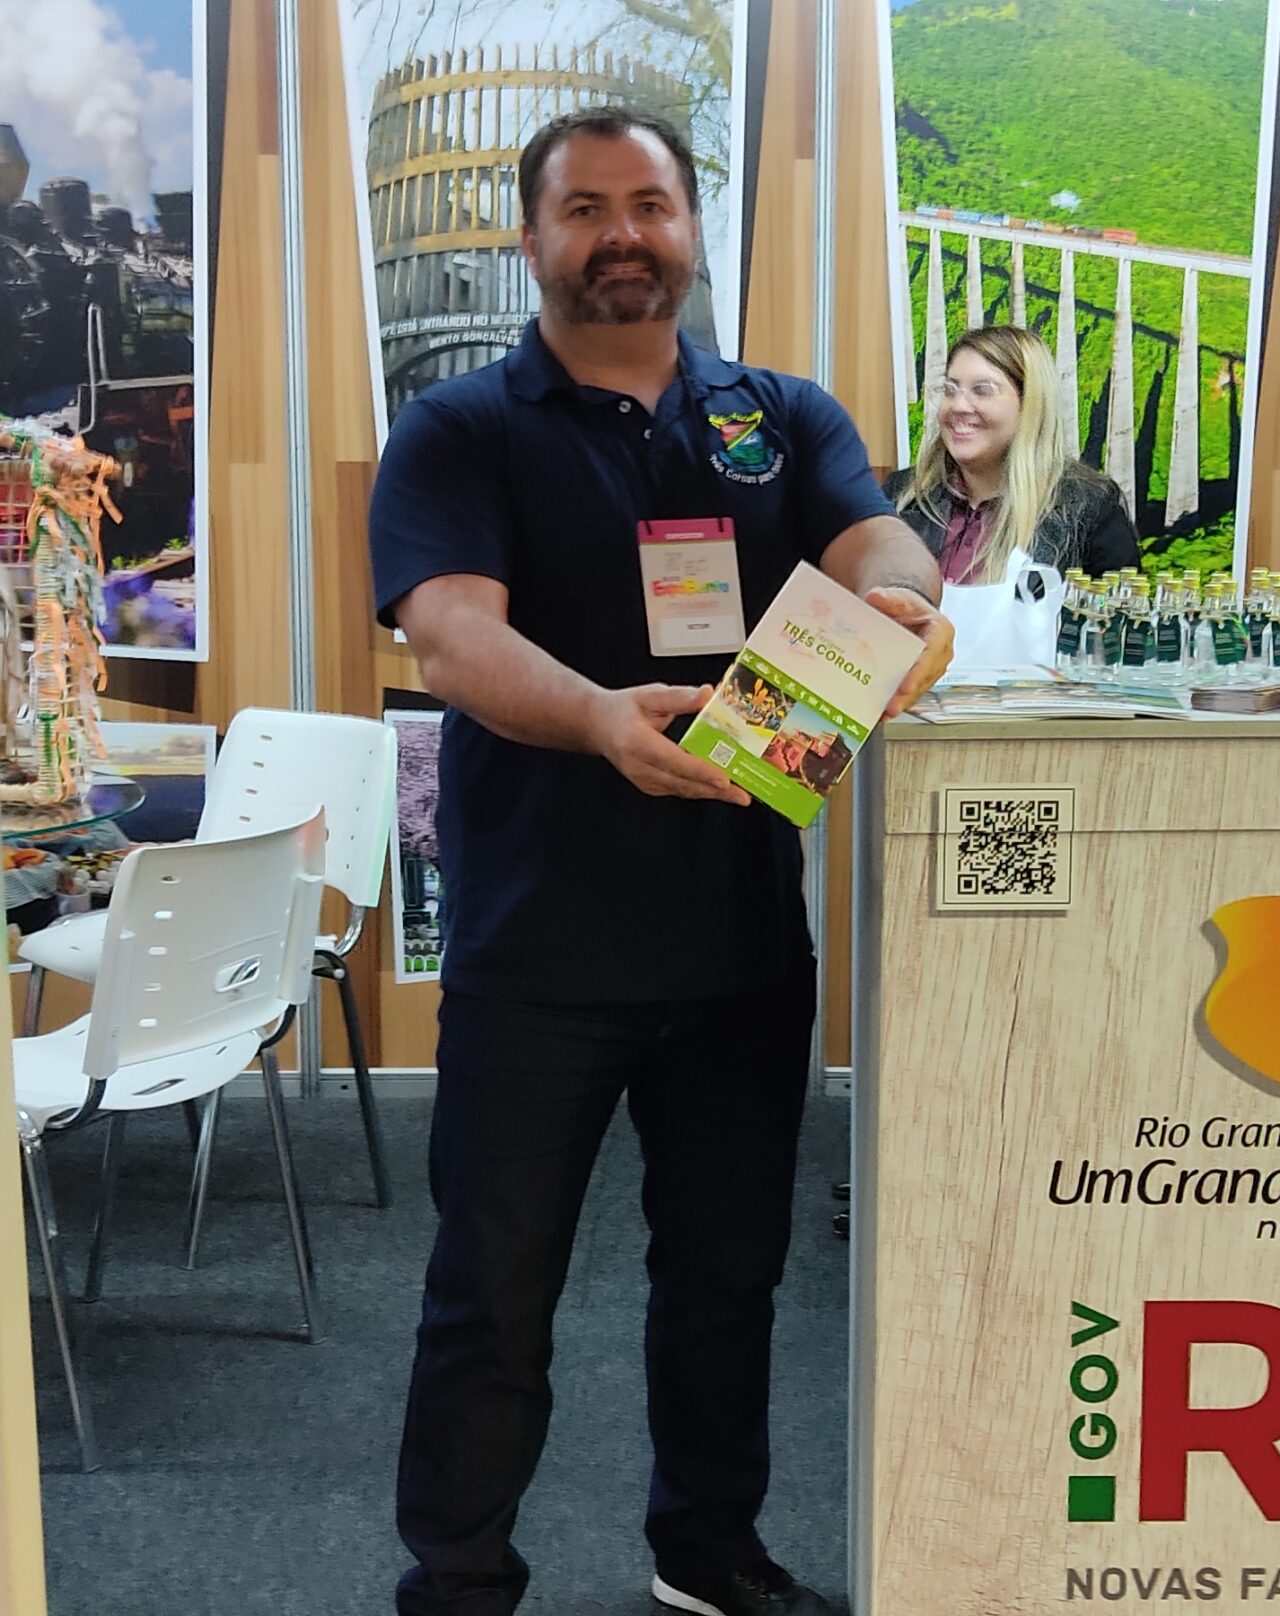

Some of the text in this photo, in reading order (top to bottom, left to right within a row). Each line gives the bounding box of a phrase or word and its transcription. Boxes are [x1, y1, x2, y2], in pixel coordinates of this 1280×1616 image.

[783, 619, 872, 686] TRÊS COROAS
[1134, 1117, 1191, 1148] Rio
[1069, 1300, 1120, 1461] GOV
[1066, 1566, 1221, 1601] NOVAS
